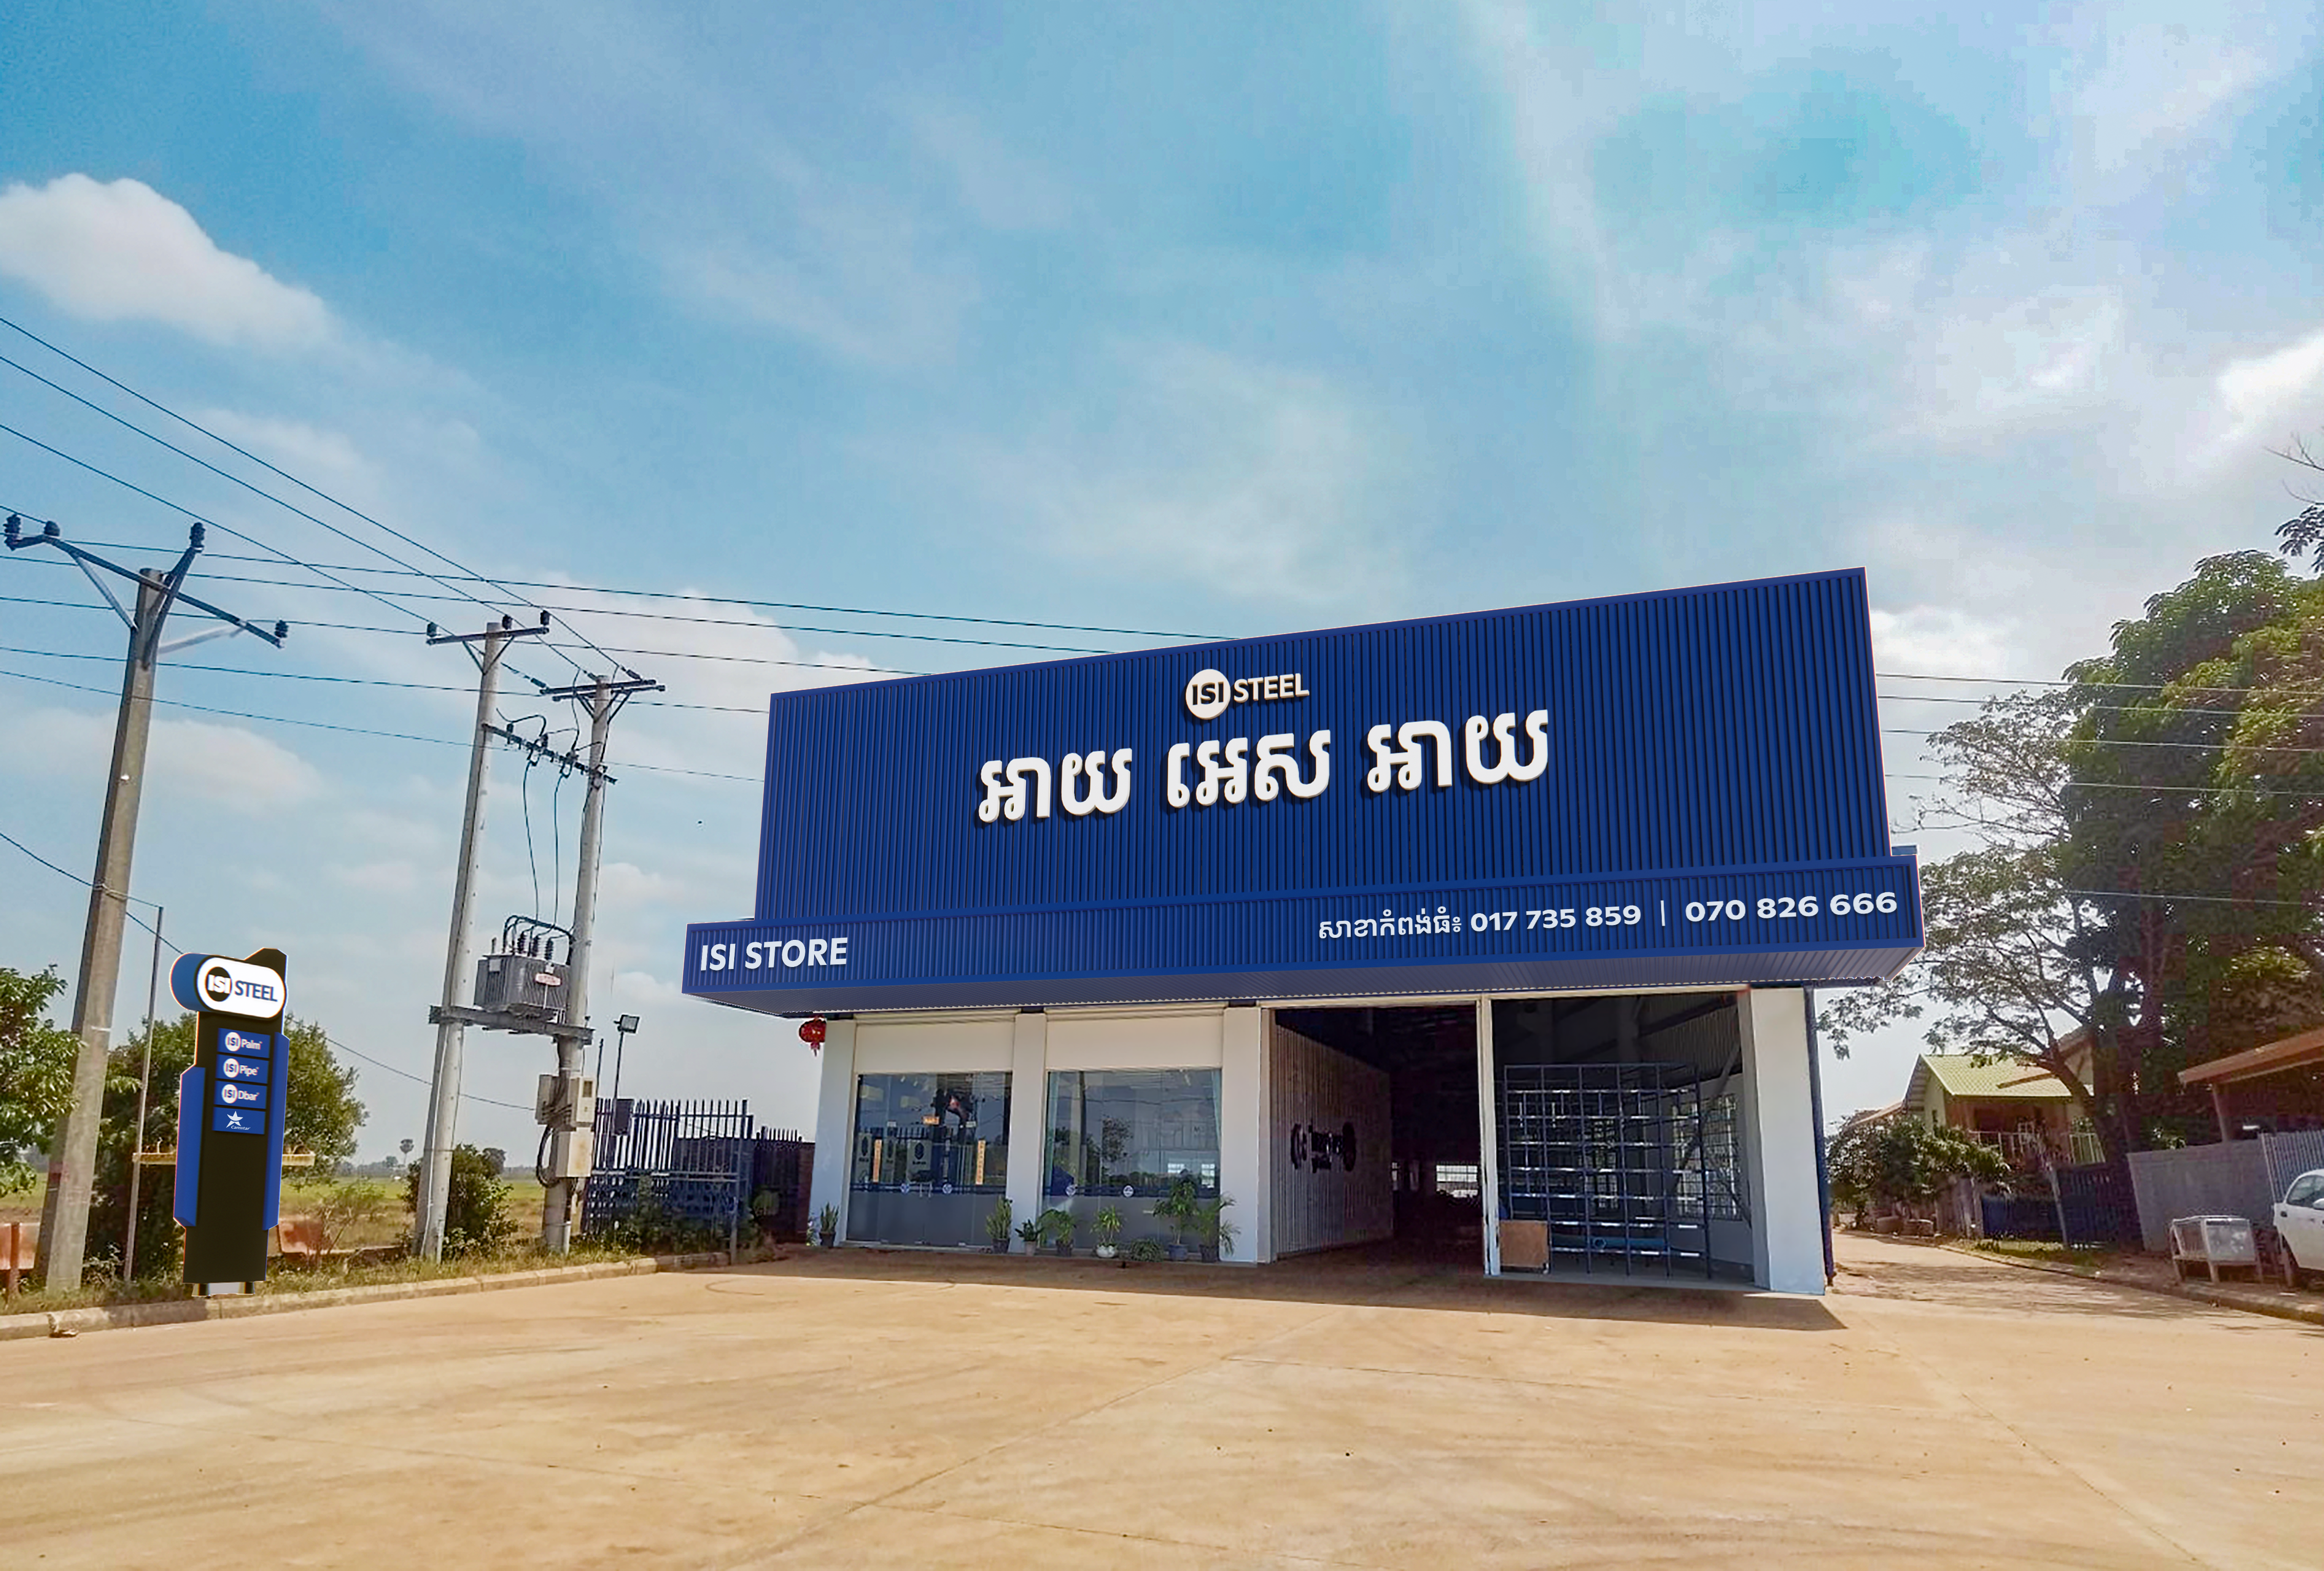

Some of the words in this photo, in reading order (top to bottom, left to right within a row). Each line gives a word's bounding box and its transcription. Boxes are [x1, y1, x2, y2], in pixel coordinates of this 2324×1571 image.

[1192, 681, 1224, 706] ISI
[1234, 673, 1310, 703] STEEL
[978, 748, 1133, 823] អាយ
[1167, 729, 1331, 808] អេស
[1368, 709, 1549, 792] អាយ
[1470, 911, 1518, 932] 017
[1526, 909, 1576, 929] 735
[1586, 905, 1641, 927] 859
[1686, 899, 1746, 922] 070
[1757, 896, 1819, 919] 826
[1830, 892, 1897, 915] 666
[700, 943, 736, 971] ISI
[745, 937, 848, 969] STORE
[207, 974, 231, 994] ISI
[234, 980, 278, 1002] STEEL
[226, 1037, 239, 1047] ISI
[225, 1063, 237, 1073] ISI
[224, 1088, 236, 1099] ISI
